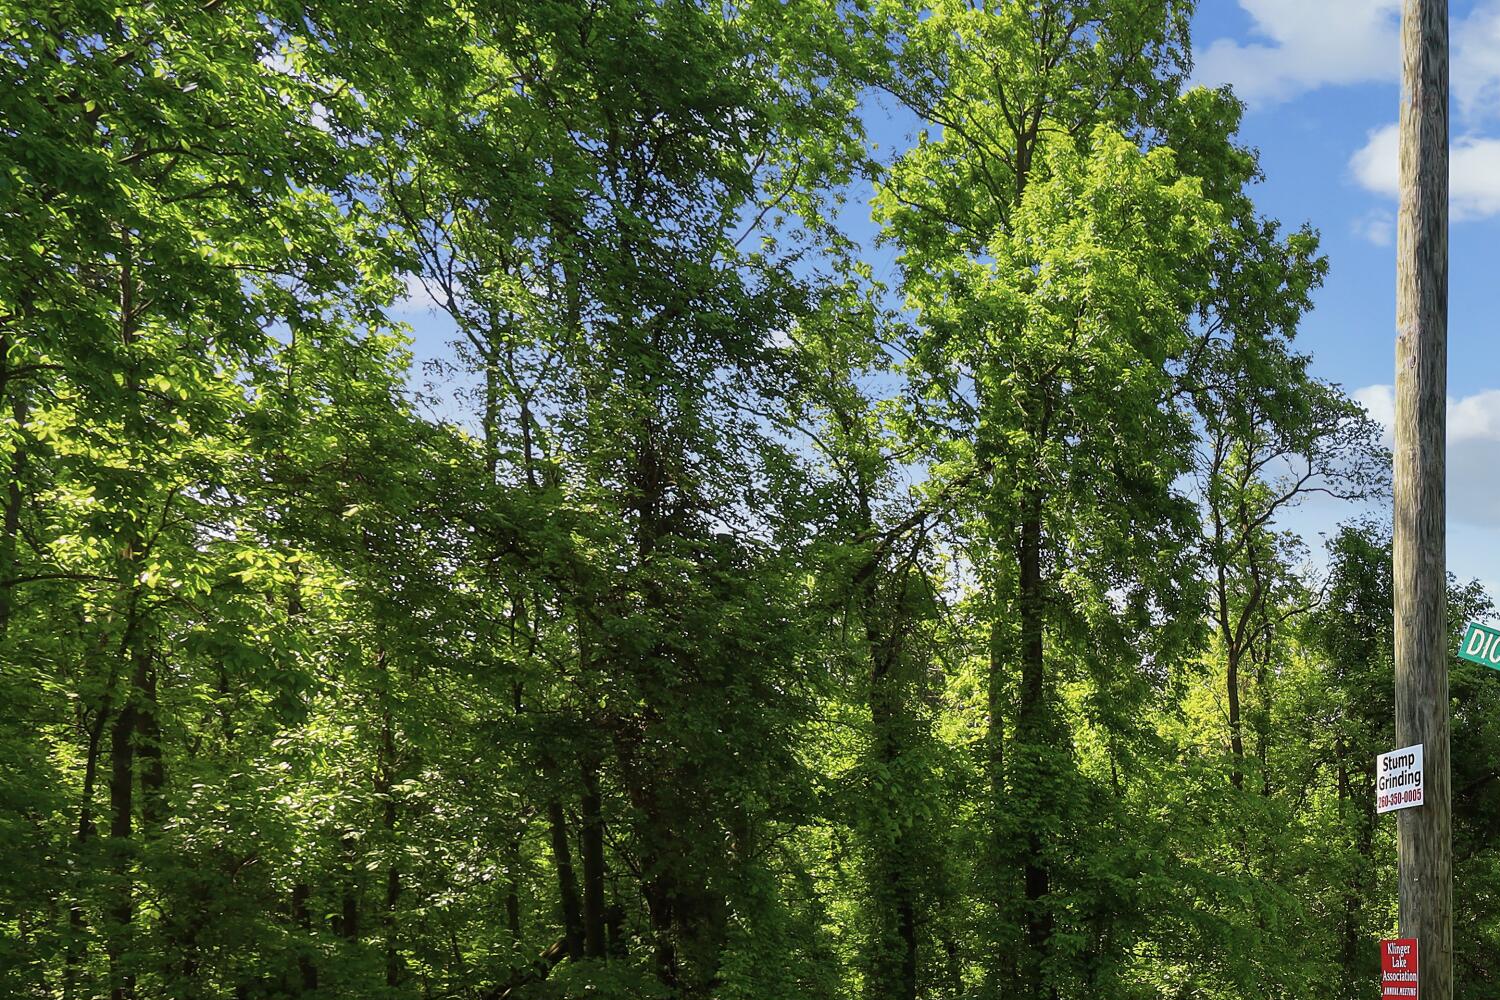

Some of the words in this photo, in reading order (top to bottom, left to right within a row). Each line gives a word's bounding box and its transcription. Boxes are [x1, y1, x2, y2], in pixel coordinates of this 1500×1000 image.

[1383, 753, 1415, 771] Stump
[1379, 770, 1421, 790] Grinding
[1387, 942, 1411, 958] Klinger
[1391, 956, 1407, 968] Lake
[1382, 970, 1417, 982] Association
